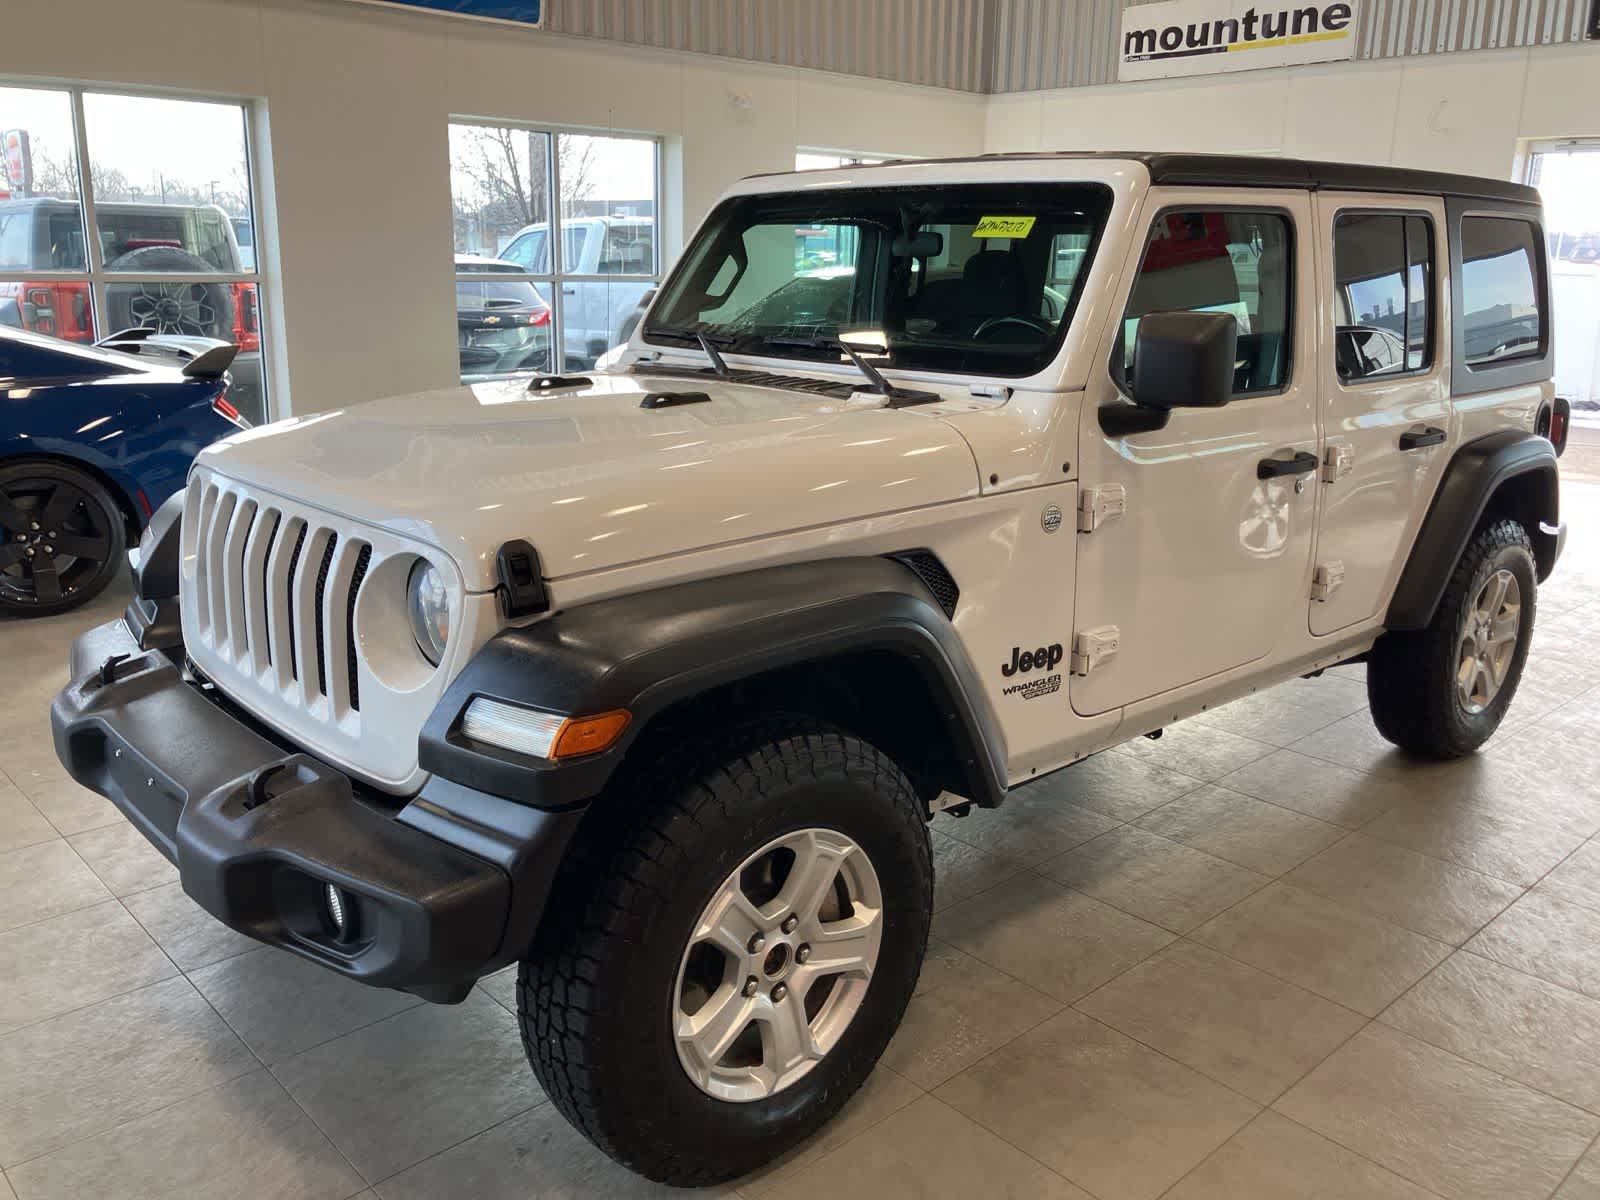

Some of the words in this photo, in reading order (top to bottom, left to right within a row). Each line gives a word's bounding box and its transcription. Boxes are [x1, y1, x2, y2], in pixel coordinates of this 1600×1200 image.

[1124, 3, 1352, 55] mountune
[1001, 643, 1063, 678] Jeep
[1002, 674, 1062, 696] WRANGLER
